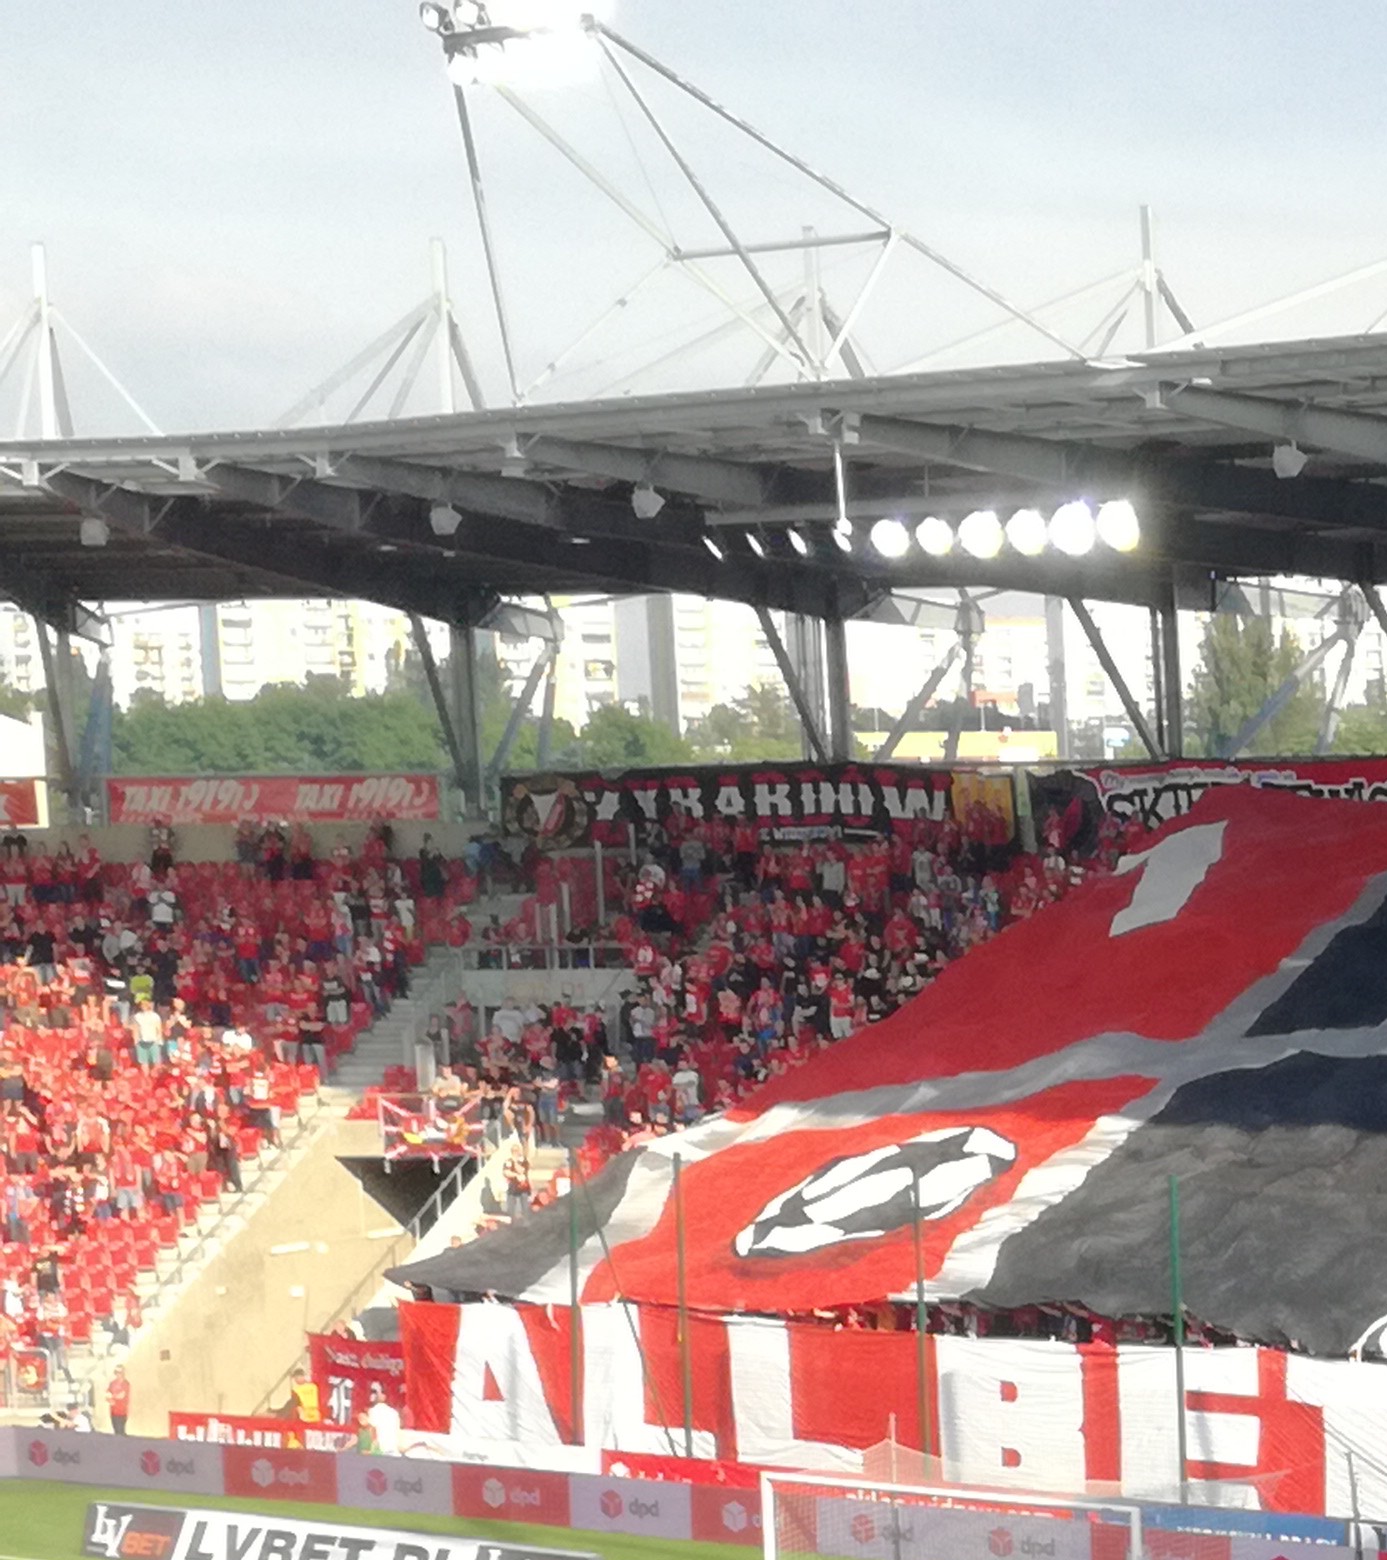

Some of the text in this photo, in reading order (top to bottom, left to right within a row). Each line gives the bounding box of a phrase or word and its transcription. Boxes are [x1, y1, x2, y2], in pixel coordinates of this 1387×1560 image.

[449, 1302, 863, 1469] ALL
[165, 1458, 195, 1476] dpd
[278, 1464, 310, 1485] dpd
[393, 1475, 423, 1495] dpd
[509, 1487, 541, 1507] dpd
[628, 1498, 660, 1519] dpd
[1019, 1535, 1055, 1560] dpd
